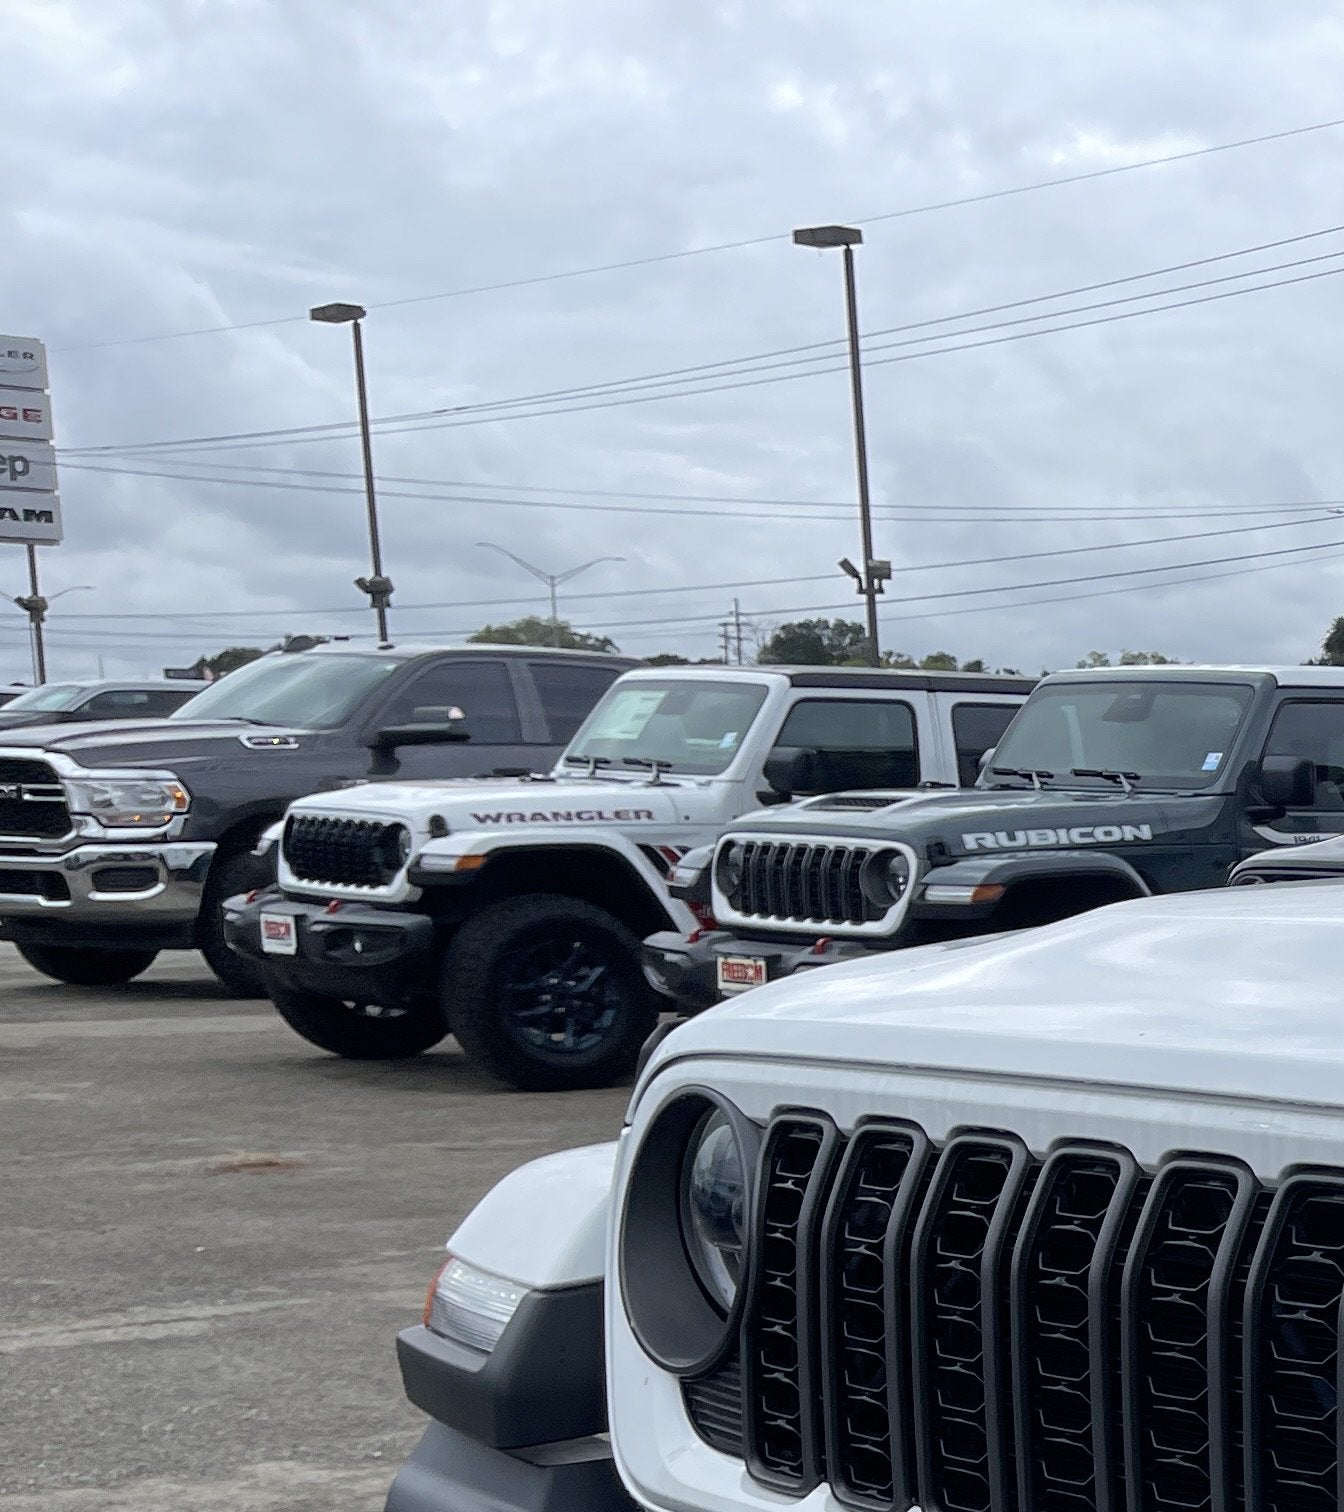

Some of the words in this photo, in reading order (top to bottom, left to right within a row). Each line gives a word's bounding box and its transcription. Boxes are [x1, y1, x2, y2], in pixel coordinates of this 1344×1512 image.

[0, 350, 35, 361] ER
[470, 808, 655, 824] WRANGLER
[961, 823, 1153, 851] RUBICON
